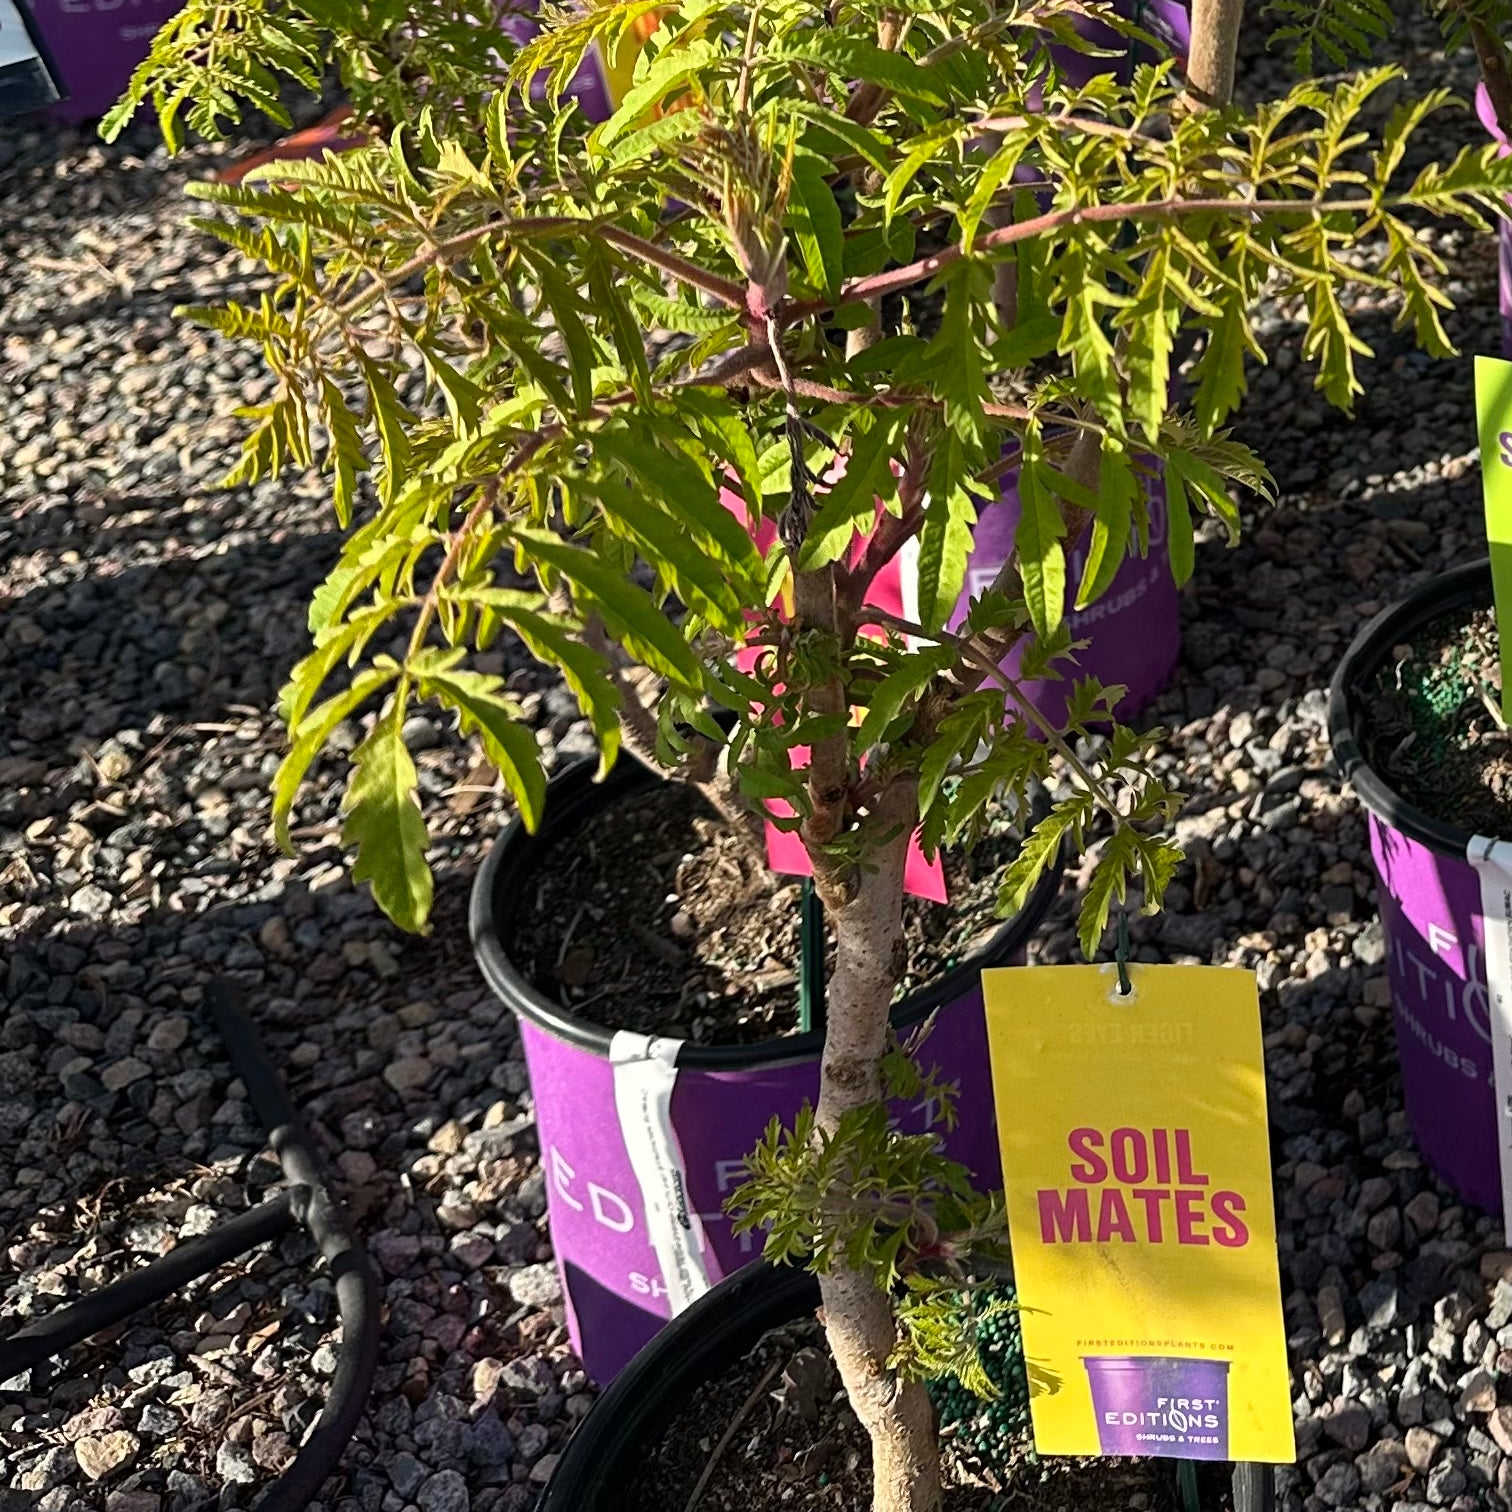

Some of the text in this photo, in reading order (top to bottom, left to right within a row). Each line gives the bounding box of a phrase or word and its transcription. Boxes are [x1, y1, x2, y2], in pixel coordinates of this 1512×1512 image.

[1068, 1127, 1209, 1186] SOIL
[1037, 1188, 1250, 1248] MATES
[1076, 1339, 1235, 1351] FIRSTEDITIONSPLANTS.COM
[1156, 1397, 1220, 1411] FIRST
[1104, 1409, 1219, 1433] EDITIONS
[1135, 1433, 1176, 1443] SHRUBS
[1187, 1435, 1219, 1444] TREES
